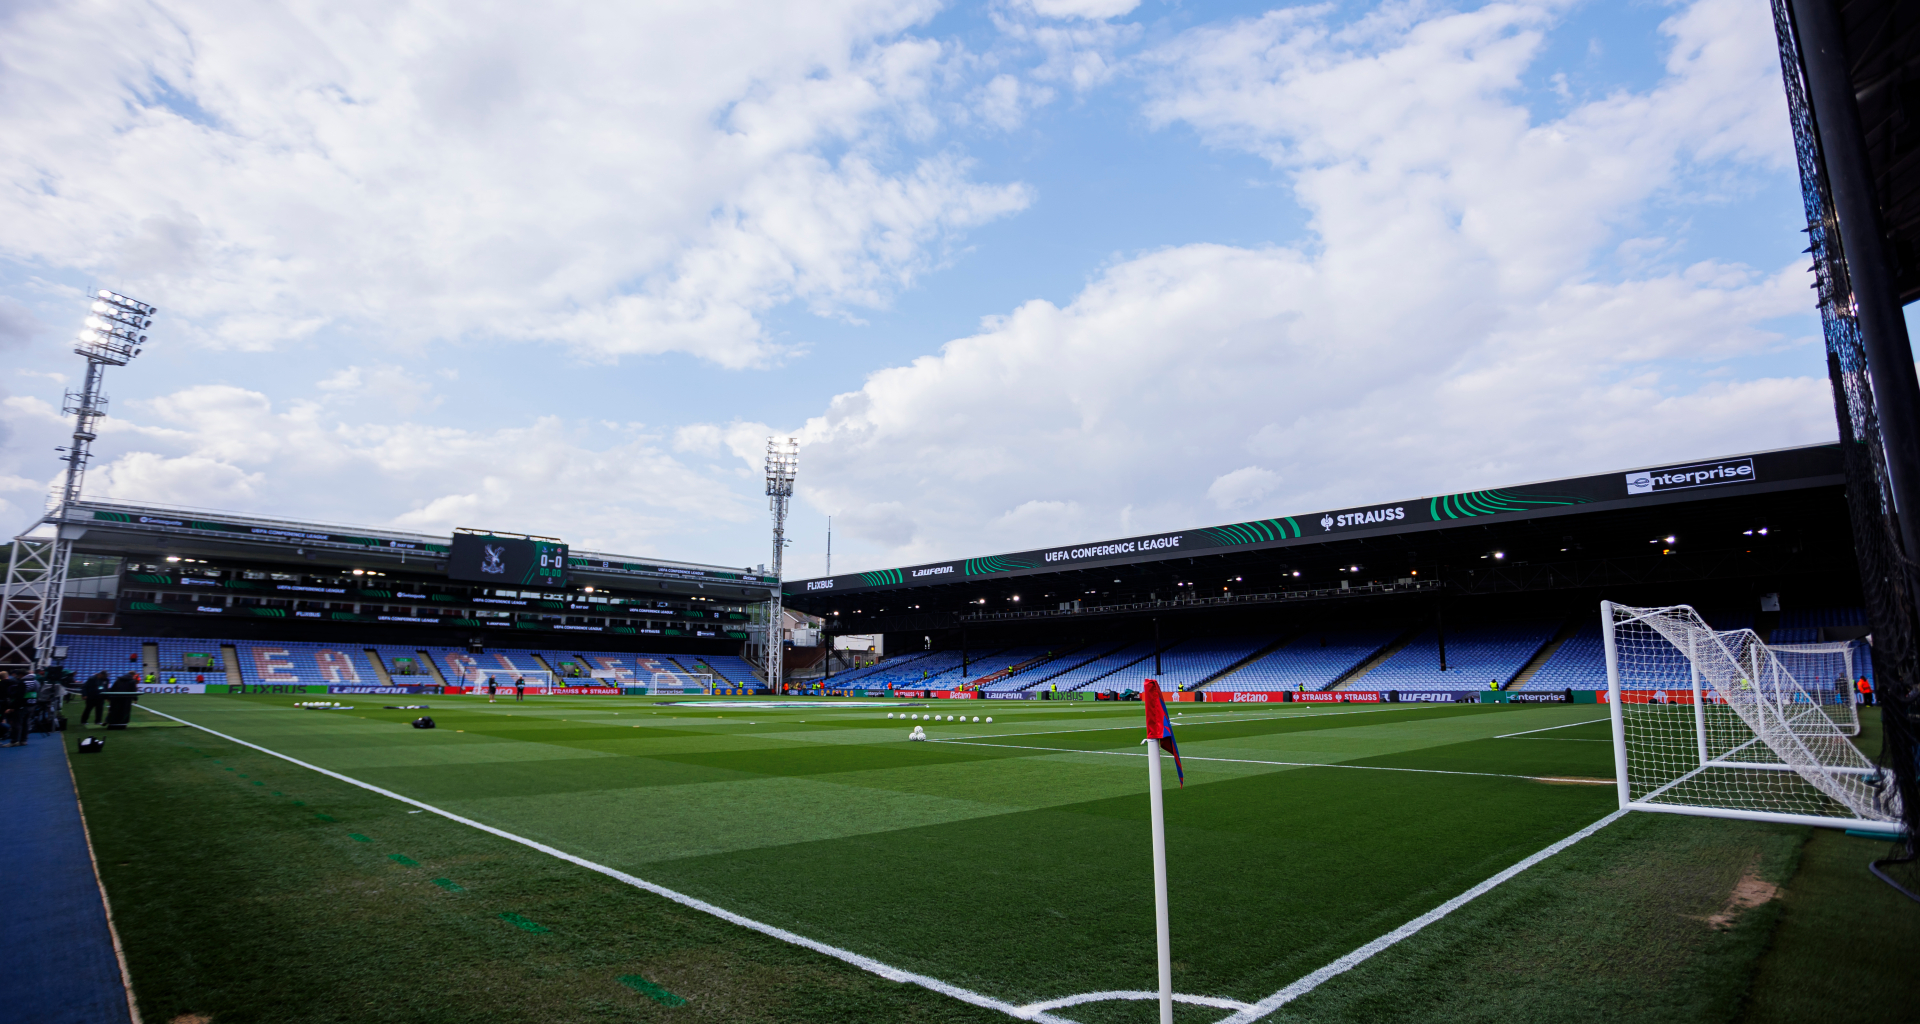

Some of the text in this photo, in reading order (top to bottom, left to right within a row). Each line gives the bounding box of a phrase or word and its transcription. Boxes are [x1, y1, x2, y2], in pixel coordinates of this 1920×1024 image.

[1633, 466, 1751, 488] enterprise
[1337, 507, 1405, 527] STRAUSS
[269, 530, 305, 538] CONFERENCE
[1045, 552, 1069, 562] UEFA
[1071, 541, 1135, 559] CONFERENCE
[137, 685, 190, 694] squote
[950, 691, 971, 699] Betano
[1233, 691, 1268, 702] Betano
[1302, 693, 1332, 701] STRAUSS
[1345, 693, 1377, 701] STRAUSS
[1510, 692, 1566, 702] enterprise
